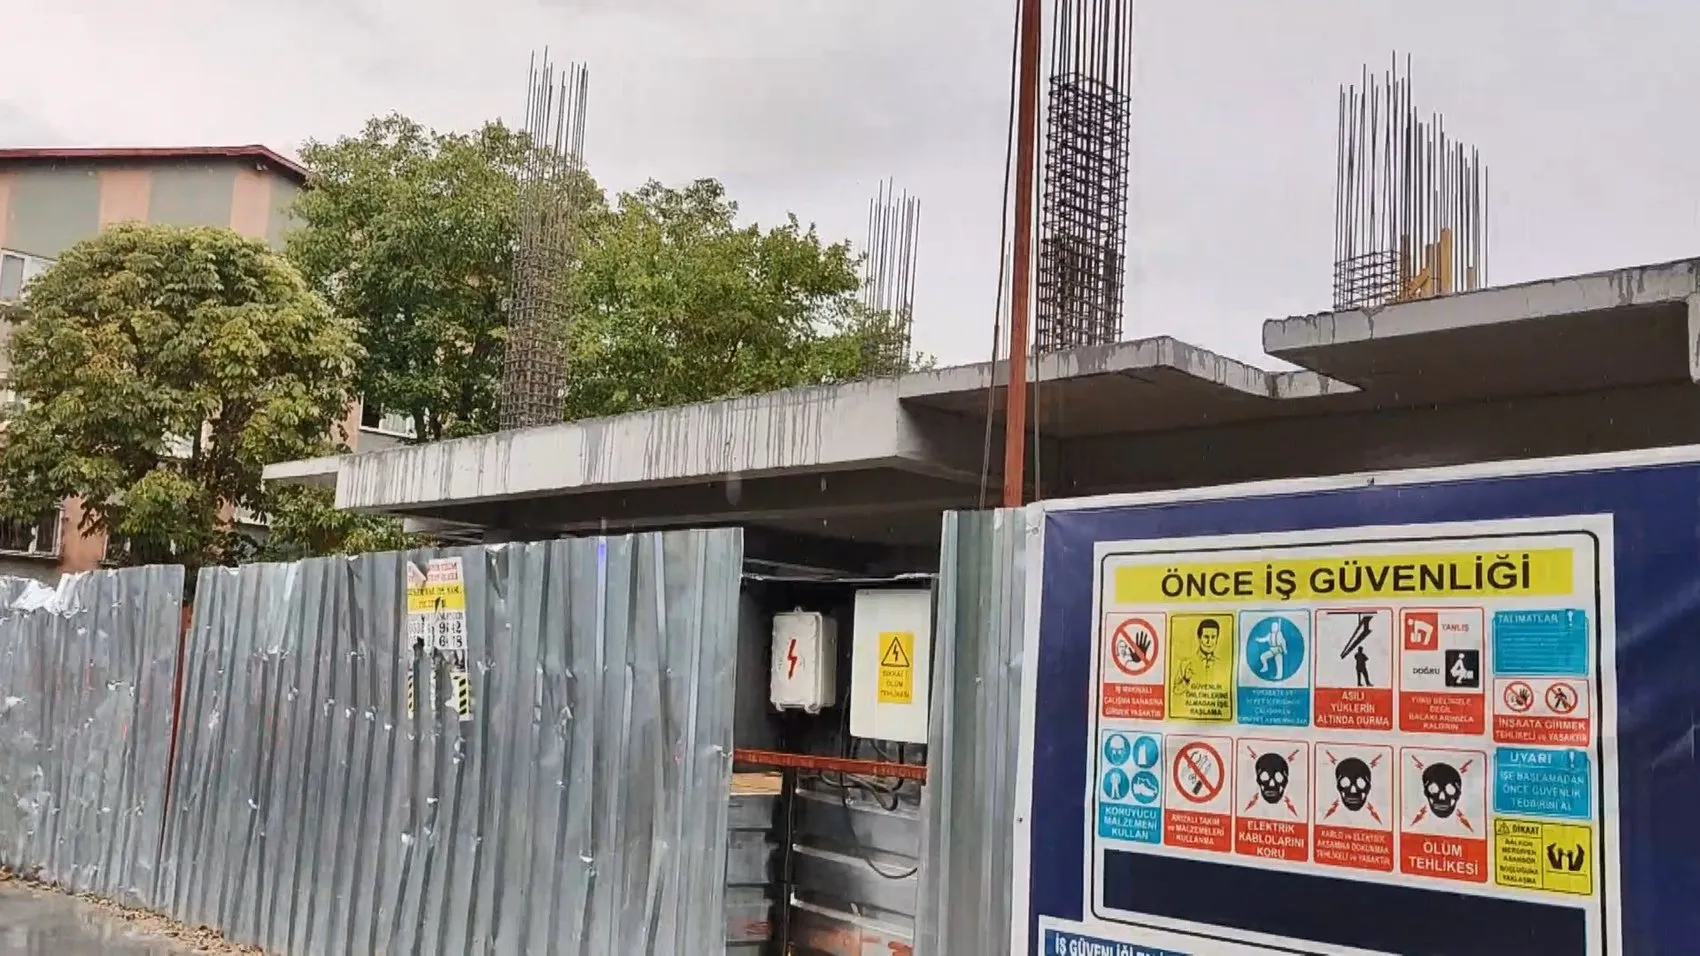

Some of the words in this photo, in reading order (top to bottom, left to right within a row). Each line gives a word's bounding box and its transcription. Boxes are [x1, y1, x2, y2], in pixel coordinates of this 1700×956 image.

[1161, 568, 1253, 597] ÖNCE
[1265, 564, 1296, 600] İŞ
[1309, 554, 1530, 594] GÜVENLİĞİ
[1341, 690, 1365, 702] ASILI
[1317, 713, 1355, 725] ALTINDA
[1356, 715, 1390, 727] DURMA
[1510, 751, 1553, 764] UYARI
[1105, 805, 1157, 820] KORUYUCU
[1111, 828, 1149, 840] KULLAN
[1238, 831, 1305, 849] KABLOLARINI
[1256, 846, 1286, 860] KORU
[1422, 841, 1463, 859] ÖLÜM
[1408, 855, 1480, 877] TEHLİKESİ
